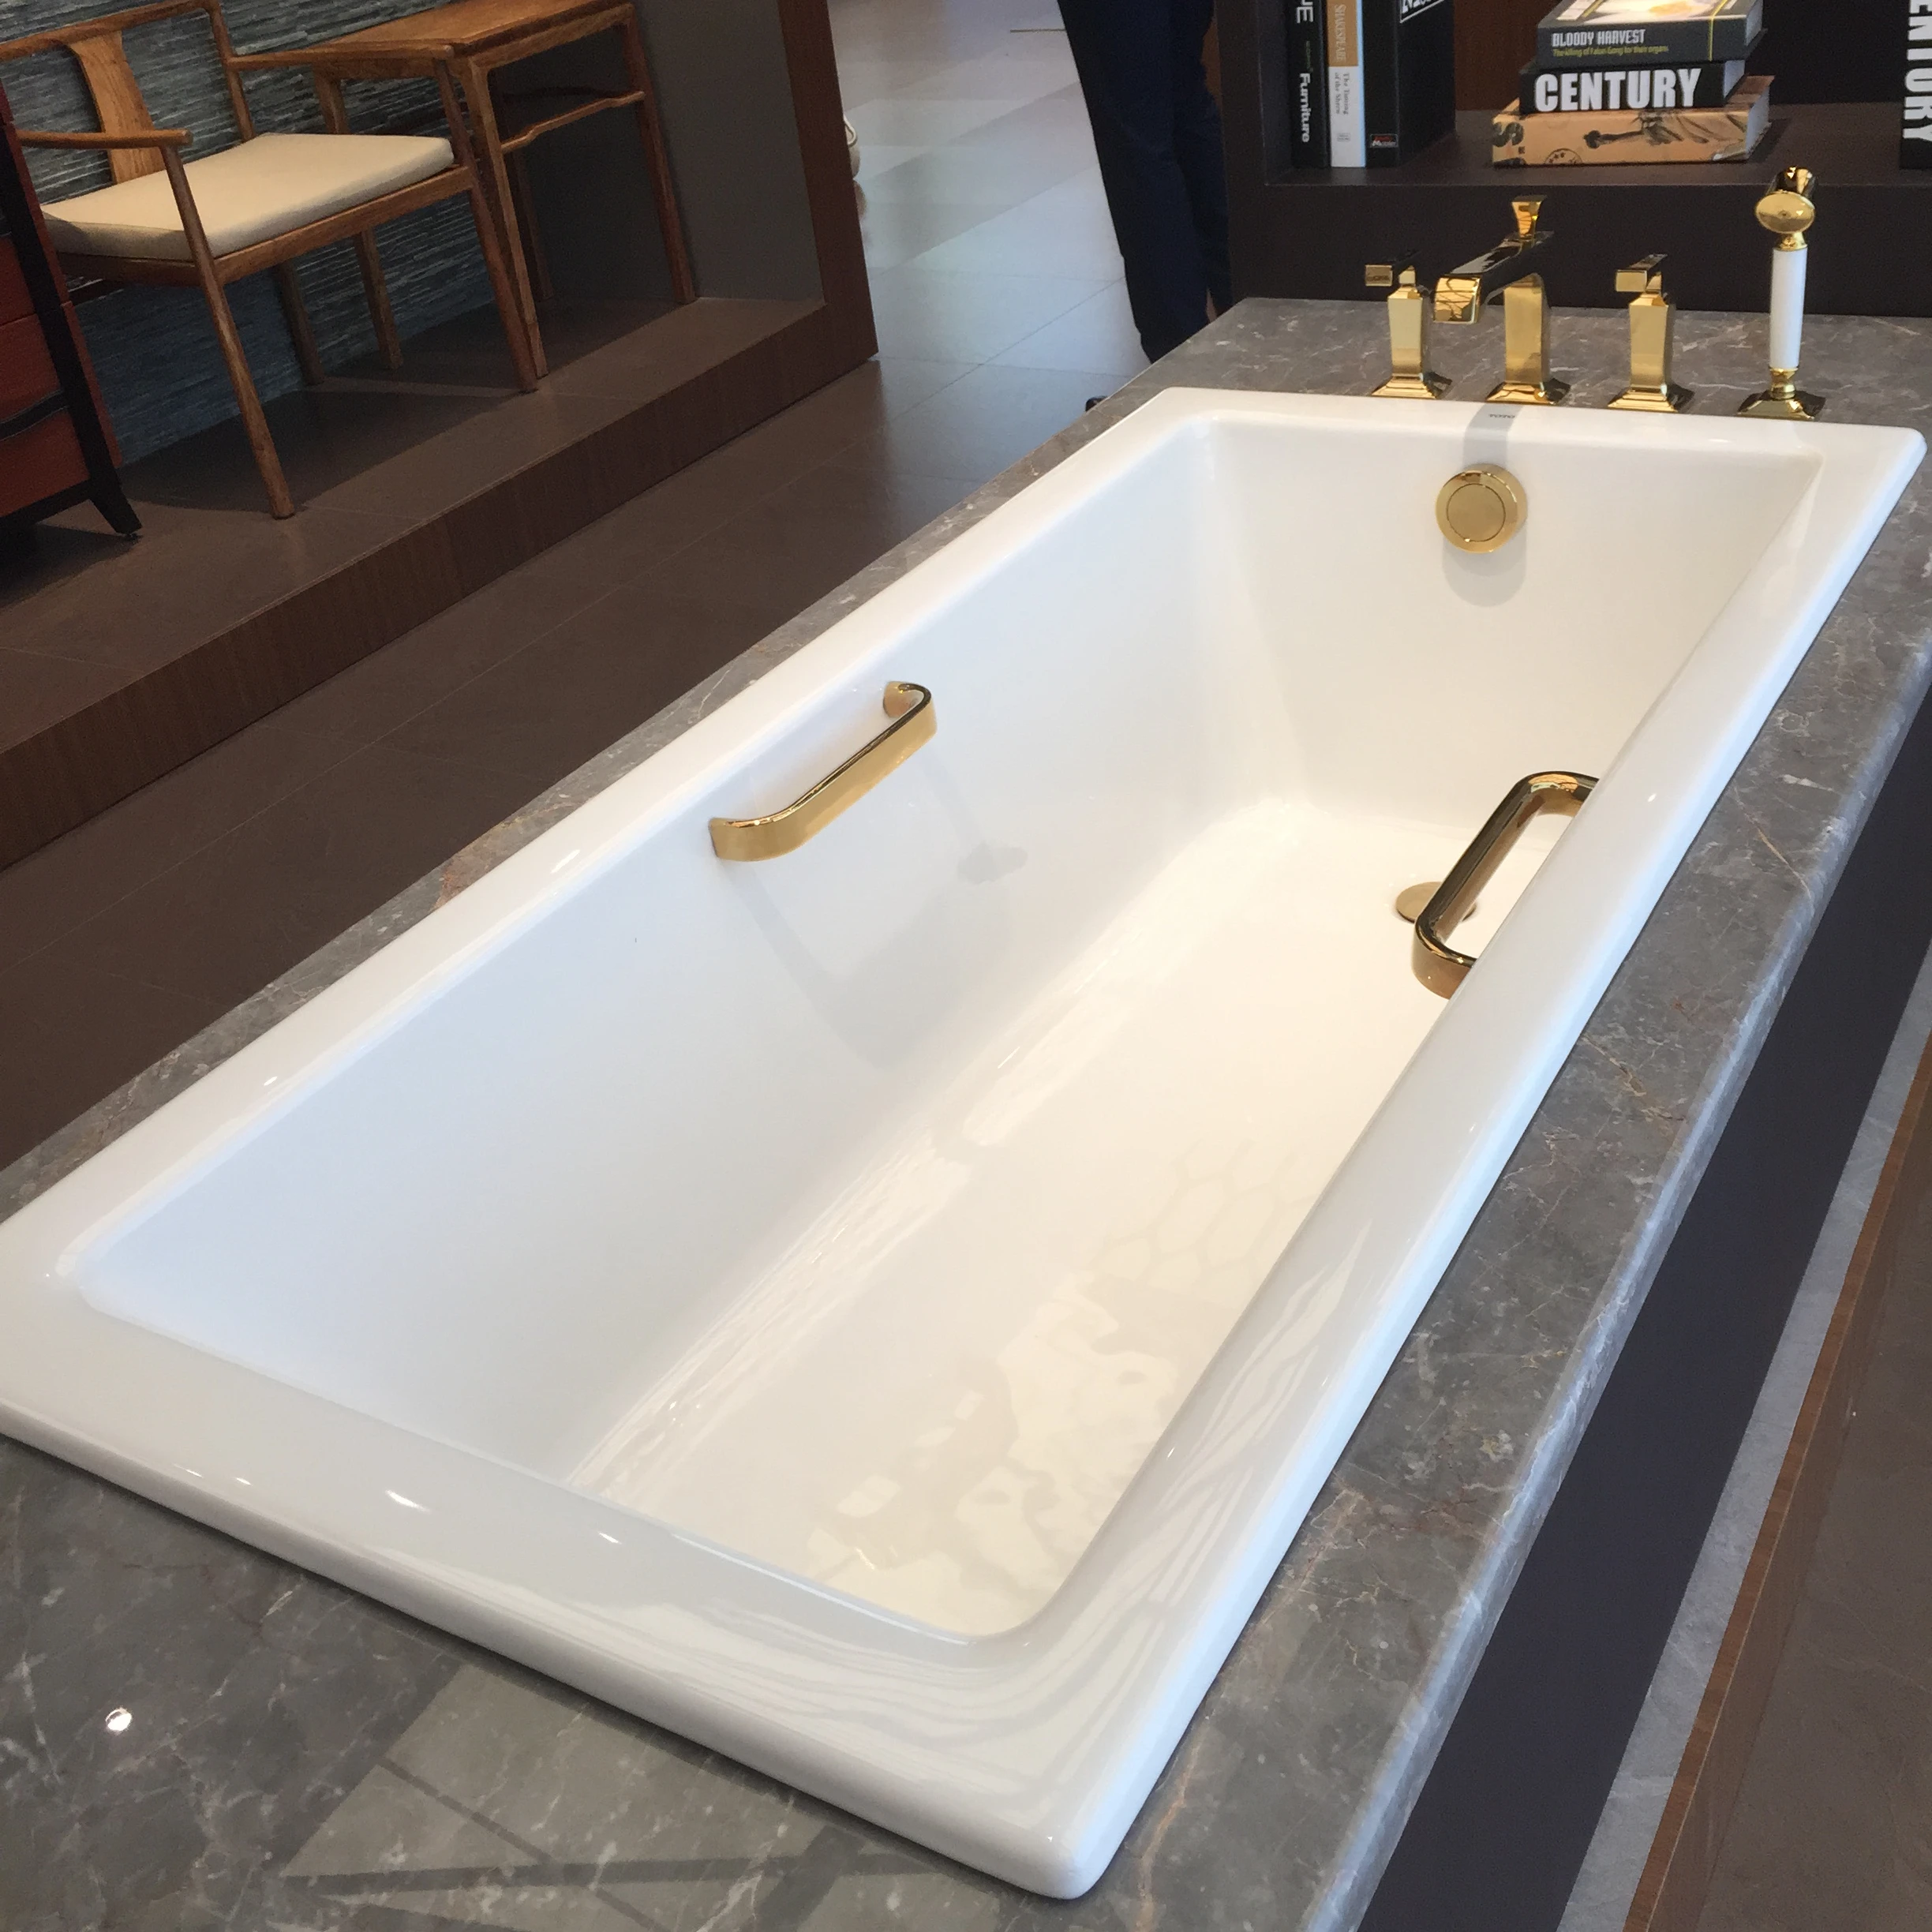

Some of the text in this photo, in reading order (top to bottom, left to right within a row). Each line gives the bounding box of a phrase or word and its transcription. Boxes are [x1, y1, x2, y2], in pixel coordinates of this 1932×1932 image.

[1552, 28, 1646, 47] BLOODY HARVEST
[1299, 73, 1312, 143] Furniture
[1535, 68, 1702, 112] CENTURY
